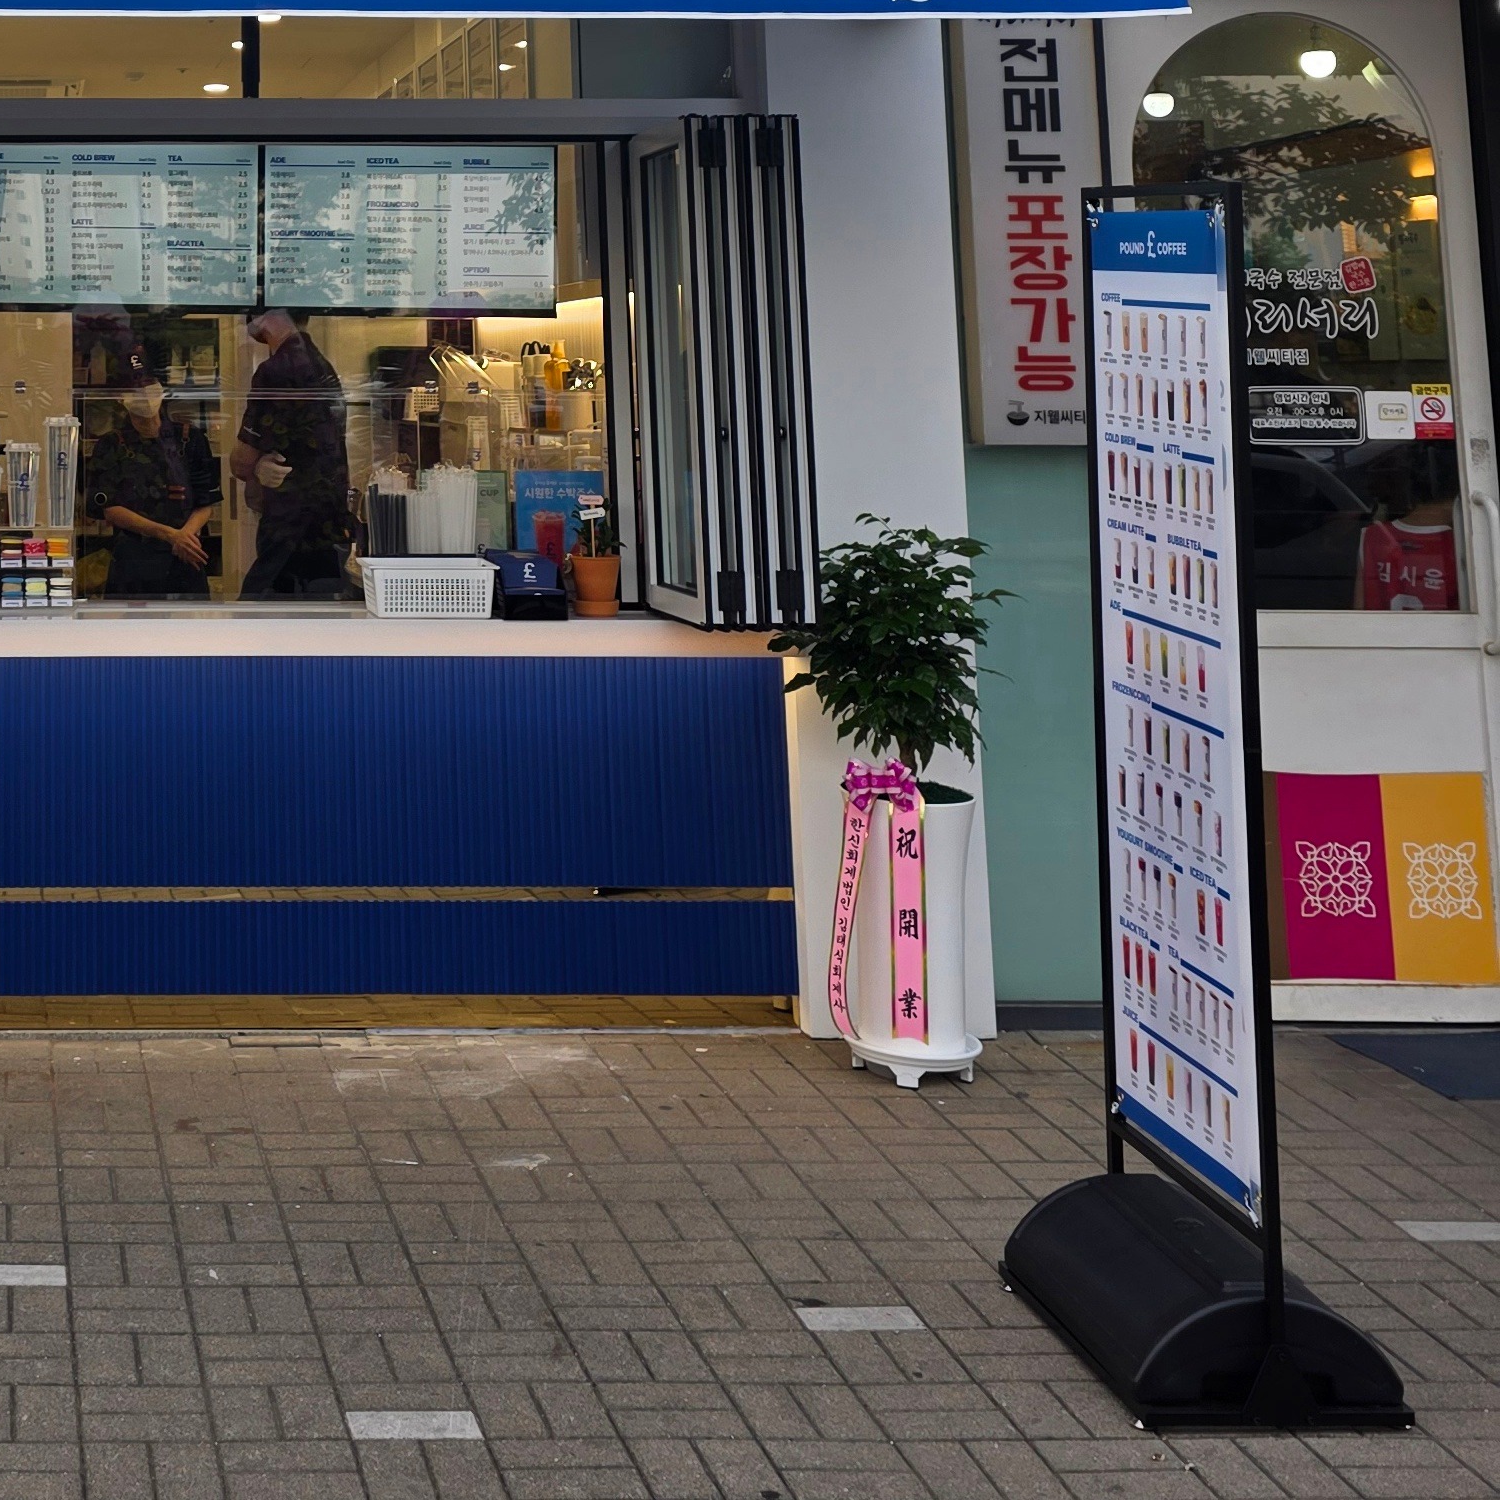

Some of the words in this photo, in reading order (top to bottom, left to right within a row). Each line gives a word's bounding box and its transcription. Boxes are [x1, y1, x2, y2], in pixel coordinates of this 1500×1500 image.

[168, 154, 183, 162] TEA
[270, 156, 286, 164] ADE
[71, 218, 93, 226] LATTE
[1119, 242, 1145, 255] POUND
[1157, 242, 1187, 256] COFFEE
[1245, 268, 1282, 291] 국수
[1287, 268, 1342, 291] 전문점
[1246, 297, 1379, 340] 리서리
[1104, 432, 1119, 444] COLD
[1121, 434, 1136, 447] BREW
[1163, 442, 1181, 456] LATTE
[1107, 518, 1126, 533] CREAM
[1127, 524, 1145, 537] LATTE
[1167, 533, 1189, 547] BUBBLE
[1189, 538, 1202, 550] TEA
[1110, 600, 1121, 612] ADE
[1190, 866, 1204, 882] ICED
[1204, 872, 1217, 889] TEA
[896, 827, 921, 1019] 祝開業
[1119, 915, 1136, 934] BLACK
[1136, 924, 1150, 942] TEA
[1167, 945, 1180, 961] TEA
[1122, 1005, 1139, 1025] JUICE
